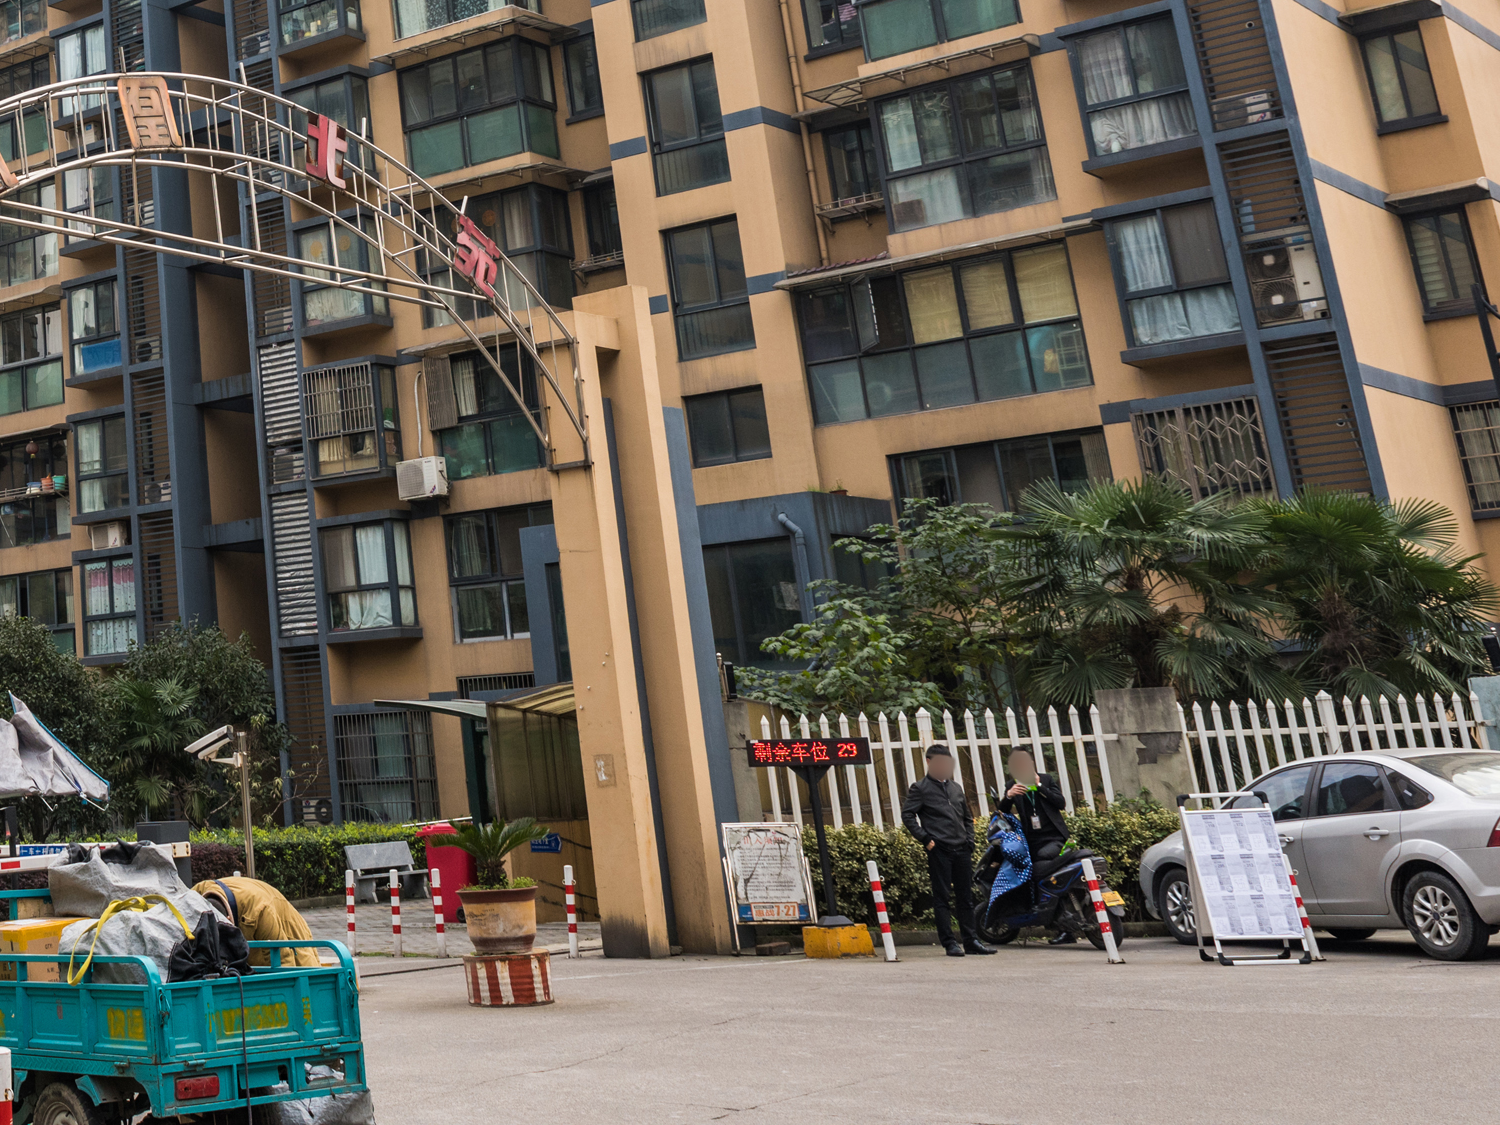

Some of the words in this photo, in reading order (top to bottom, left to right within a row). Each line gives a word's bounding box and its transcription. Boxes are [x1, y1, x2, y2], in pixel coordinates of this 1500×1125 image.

[753, 741, 831, 763] 剩余车位
[837, 742, 858, 757] 29
